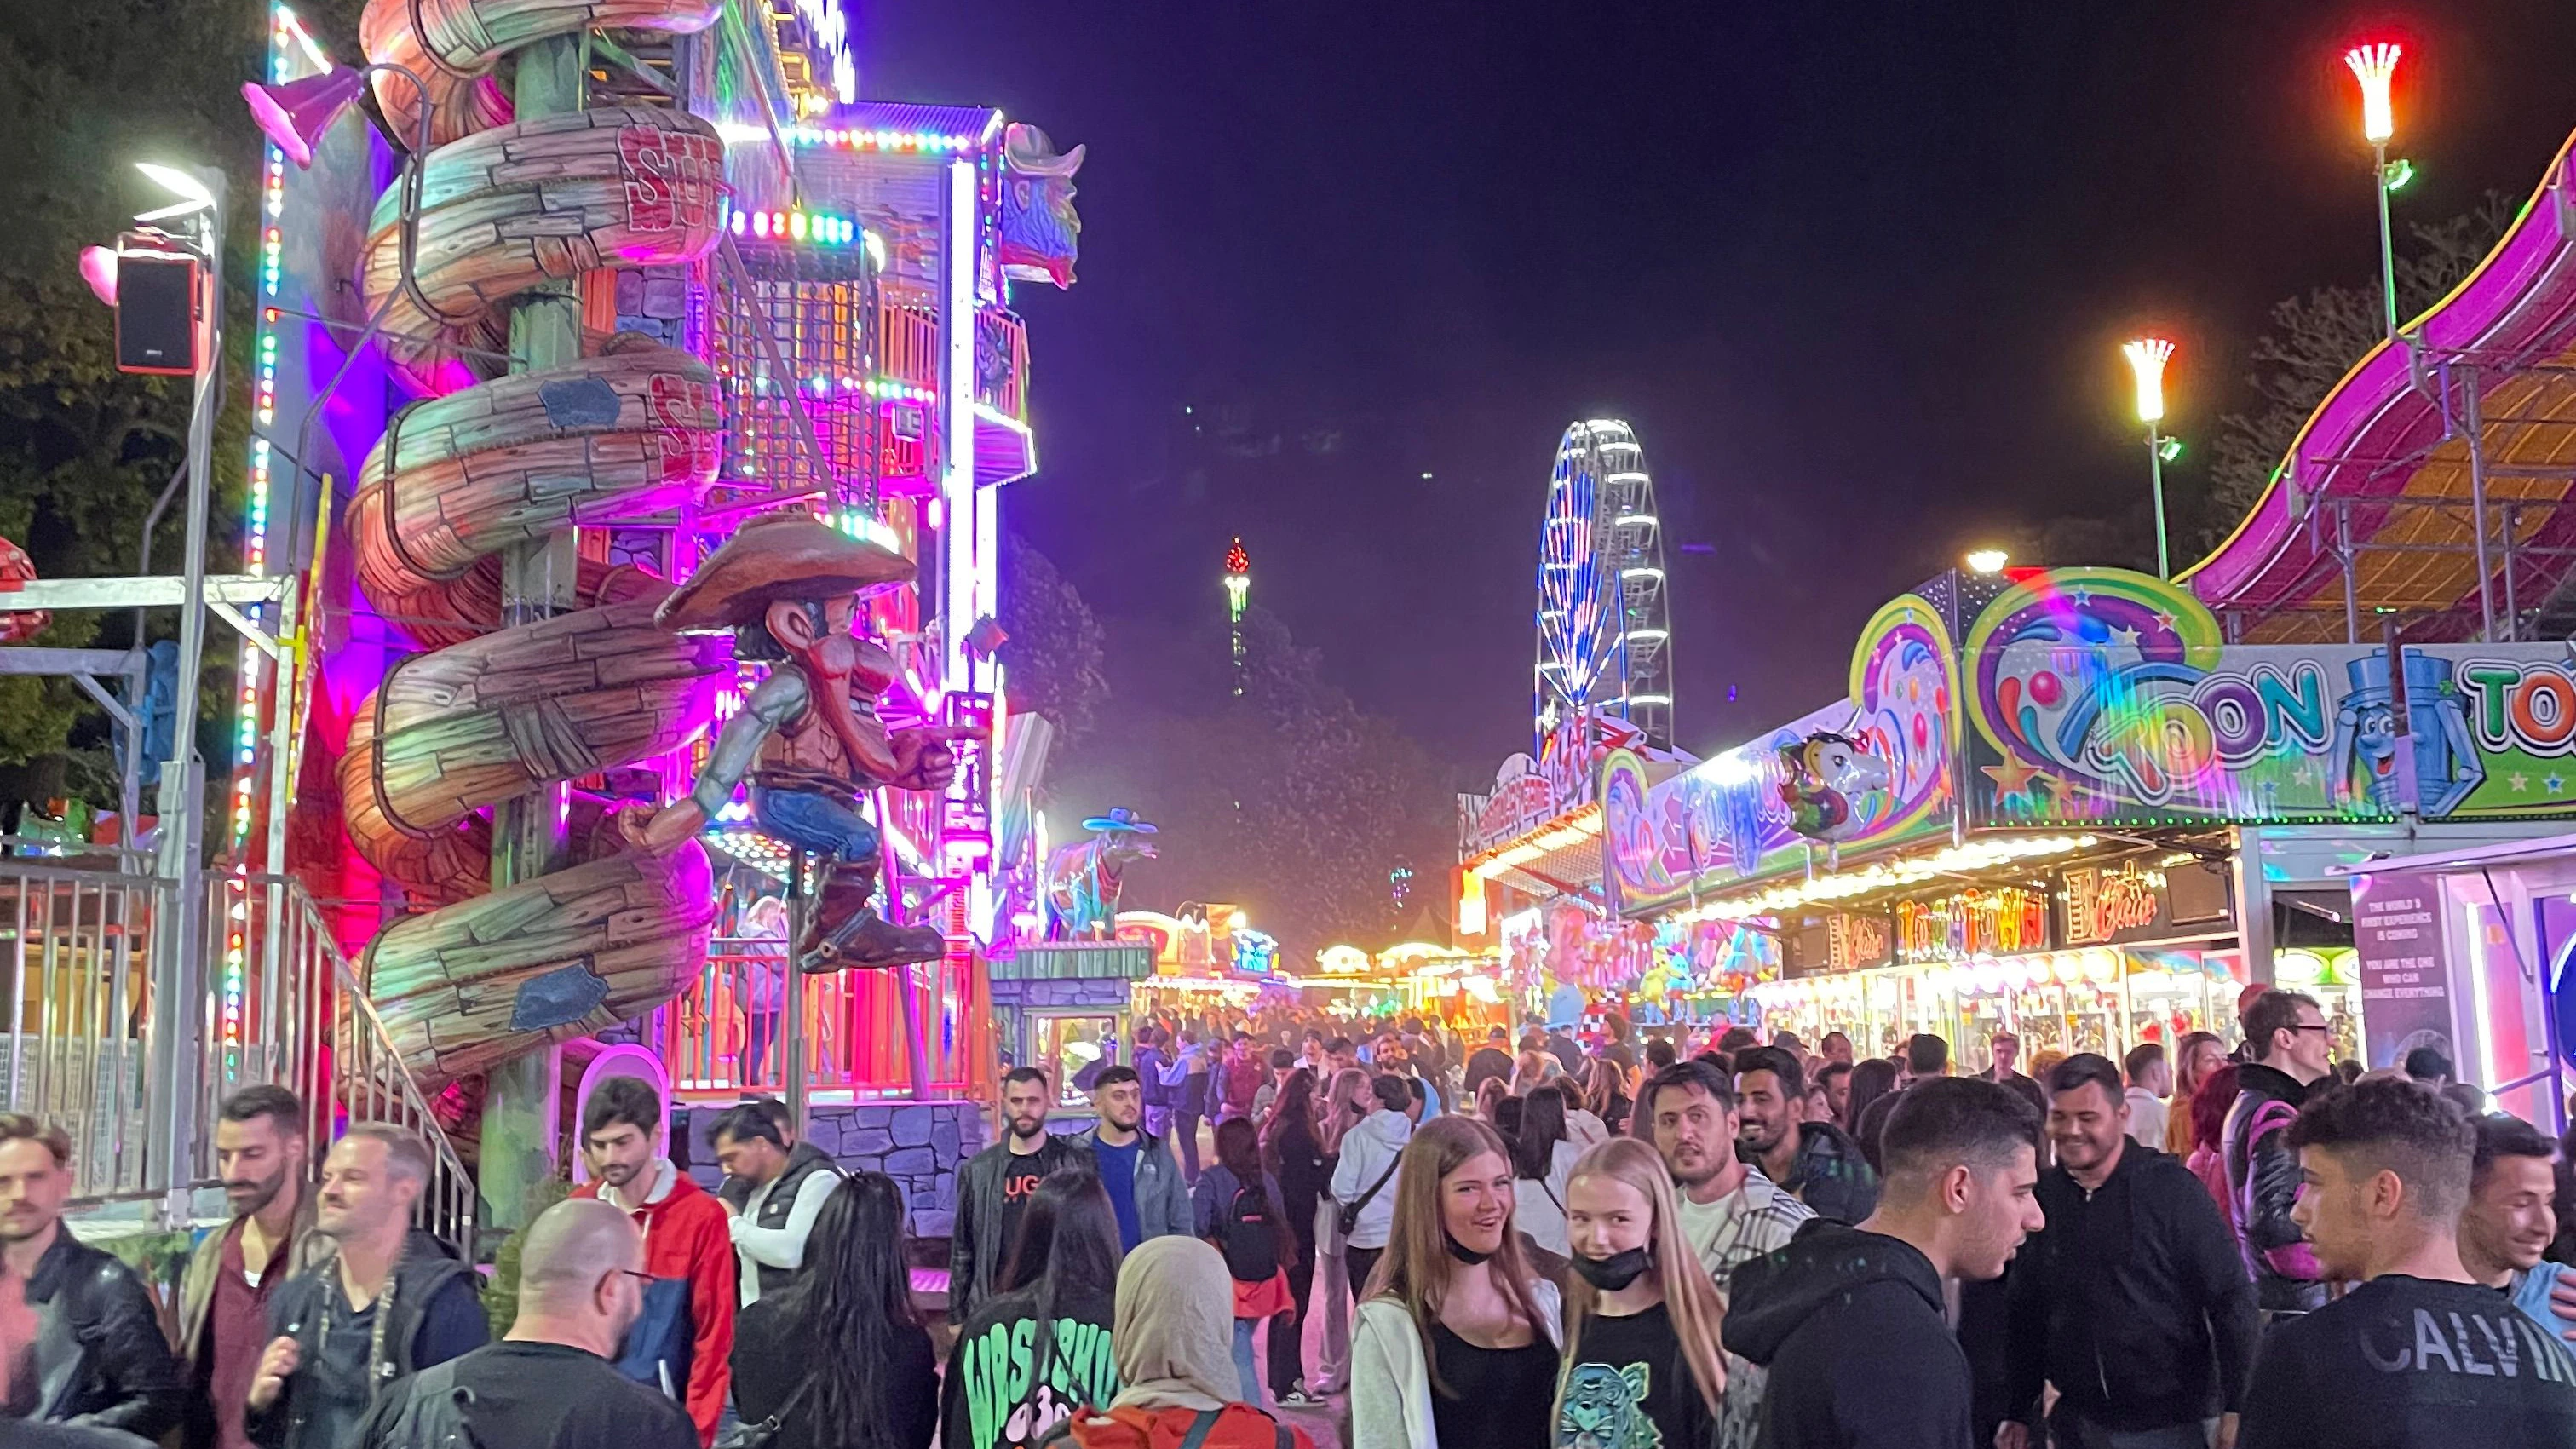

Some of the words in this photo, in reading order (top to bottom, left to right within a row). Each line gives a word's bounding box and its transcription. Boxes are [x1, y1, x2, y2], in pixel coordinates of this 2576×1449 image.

[2087, 658, 2336, 808] TOON
[2383, 912, 2431, 926] EXPERIENCE
[2386, 928, 2418, 940] COMING
[2366, 960, 2382, 969] YOU
[2401, 957, 2416, 969] THE
[2418, 957, 2434, 968] ONE
[2402, 972, 2419, 983] CAN
[2395, 986, 2445, 998] EVERYTHING
